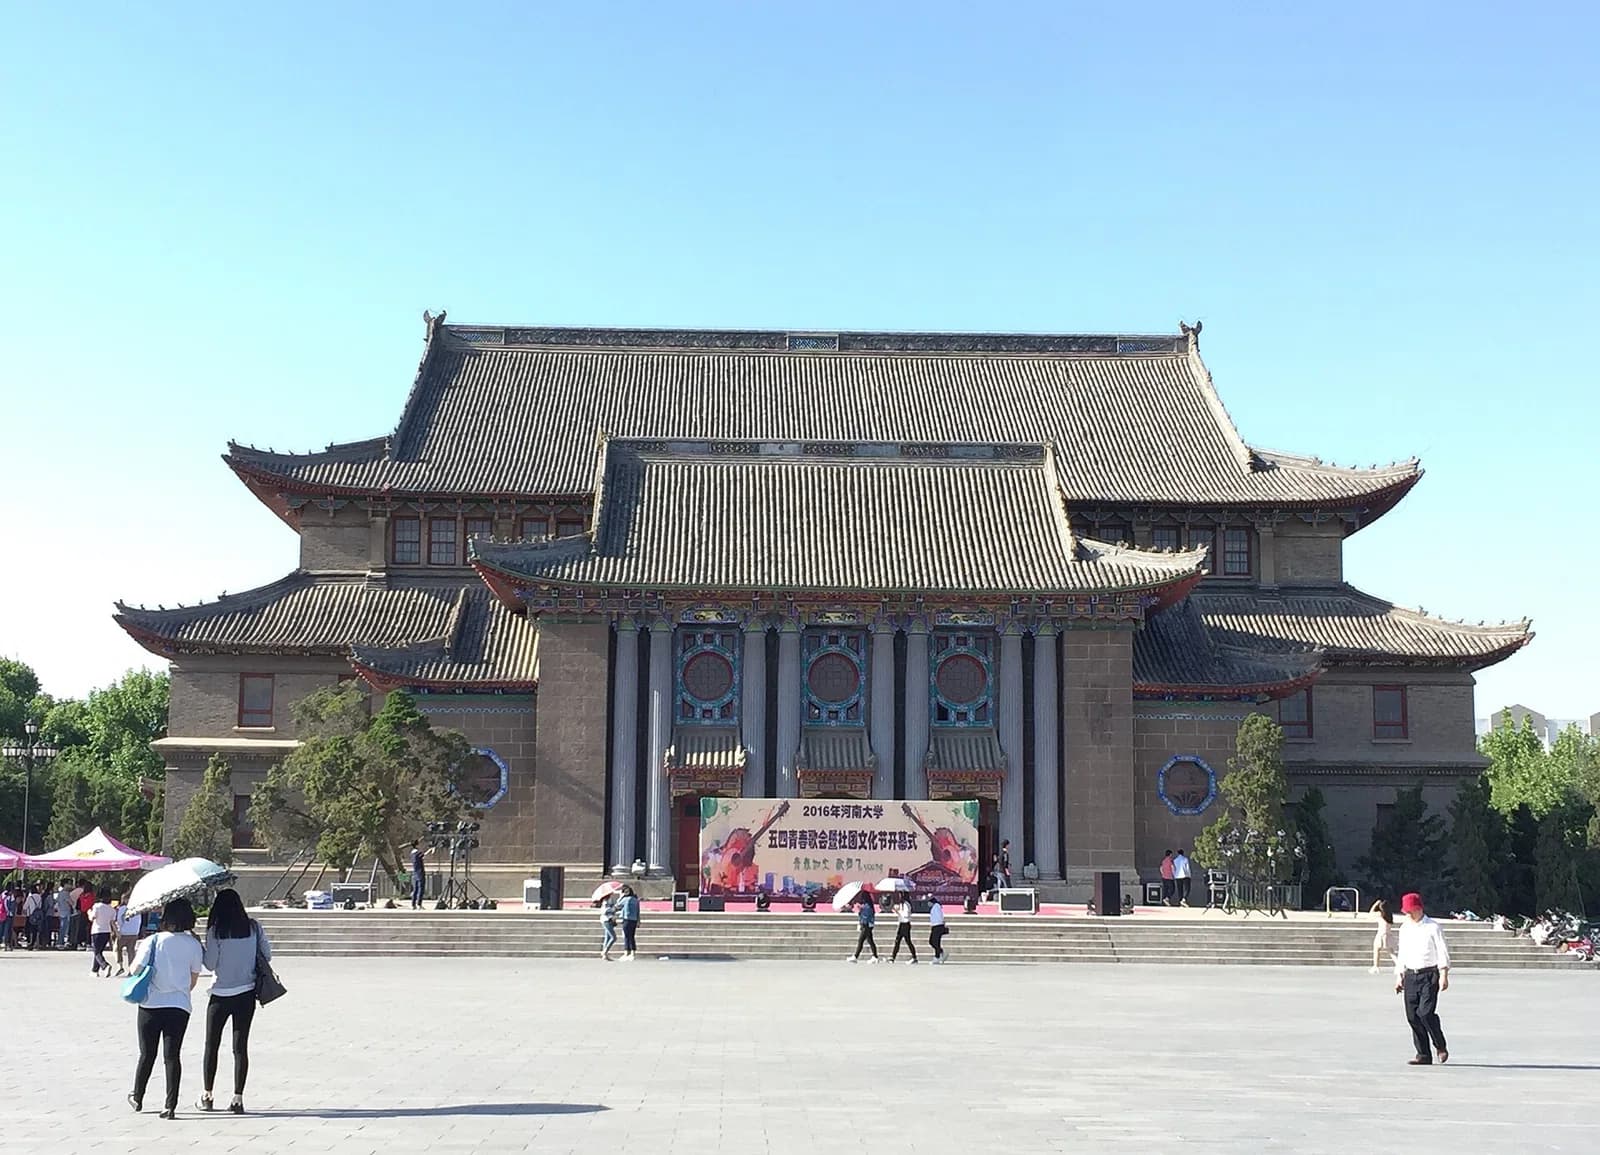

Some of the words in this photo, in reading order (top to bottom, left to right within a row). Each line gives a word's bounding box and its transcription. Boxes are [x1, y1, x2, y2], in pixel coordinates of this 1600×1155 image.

[803, 804, 884, 819] 2016年河南大学
[768, 829, 918, 850] 五四青春歌会暨社团文化节开幕式
